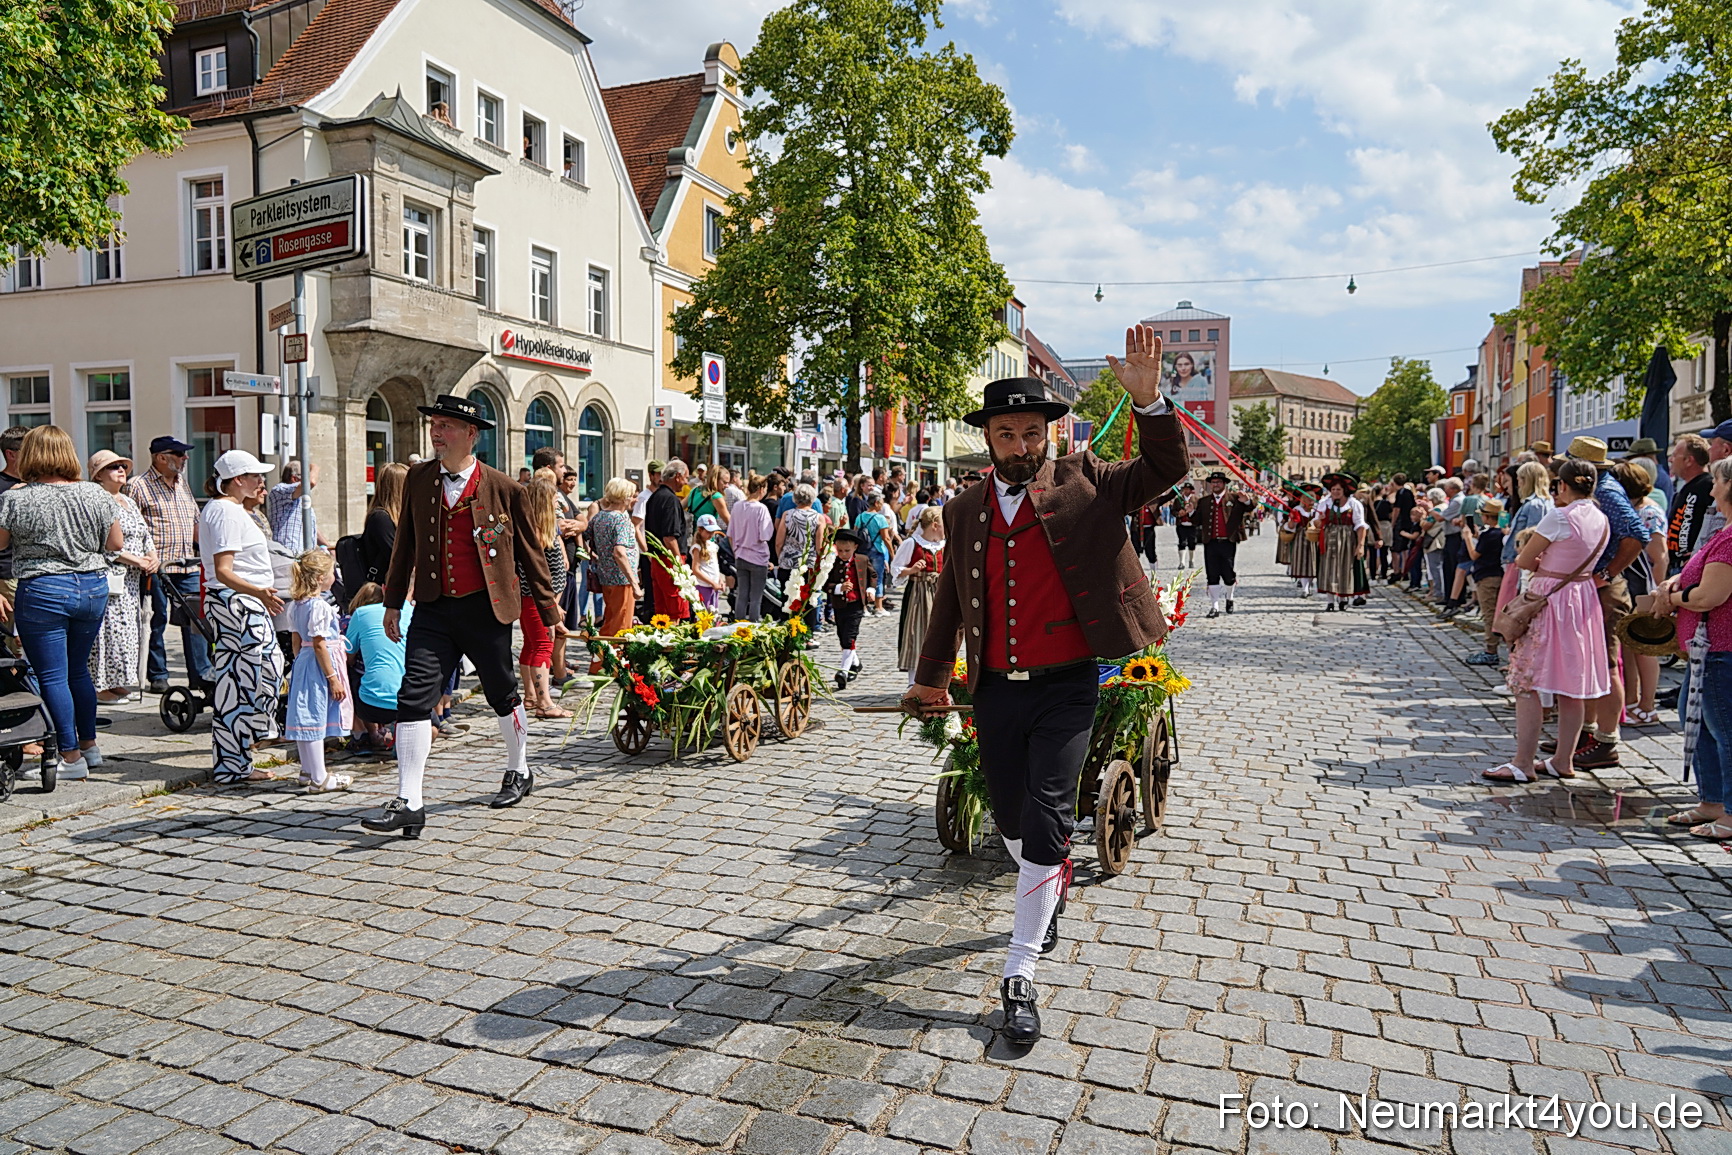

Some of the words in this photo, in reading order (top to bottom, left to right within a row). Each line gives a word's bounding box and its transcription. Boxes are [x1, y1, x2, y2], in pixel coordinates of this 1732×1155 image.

[251, 194, 331, 228] Parkleitsystem
[278, 231, 333, 254] Rosengasse
[515, 333, 593, 364] HypoVereinsbank
[709, 385, 720, 394] ZONE
[655, 407, 665, 417] EC
[1667, 503, 1687, 552] STIHL
